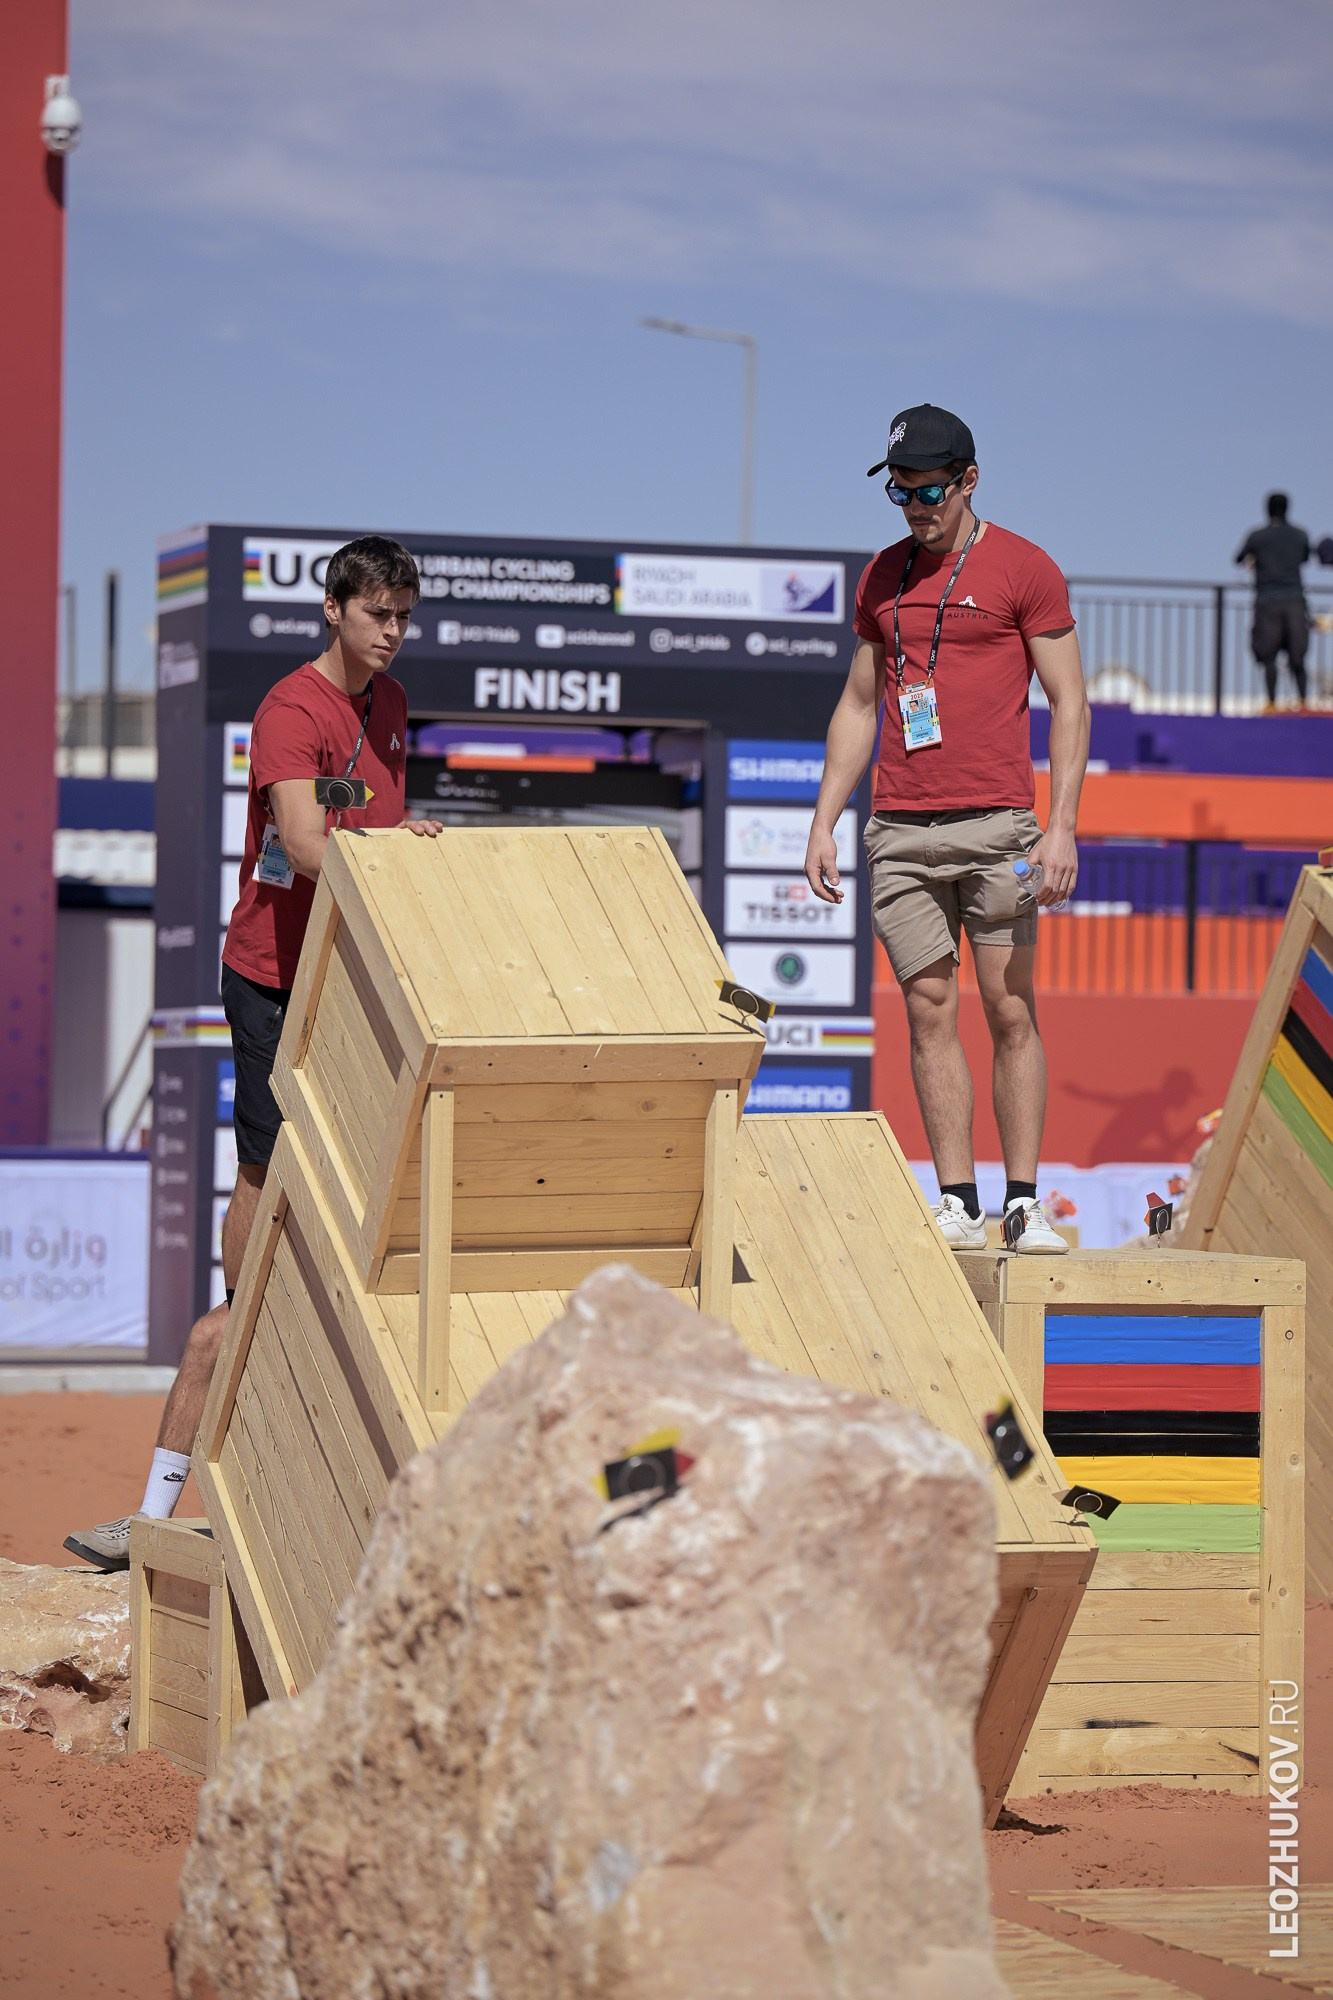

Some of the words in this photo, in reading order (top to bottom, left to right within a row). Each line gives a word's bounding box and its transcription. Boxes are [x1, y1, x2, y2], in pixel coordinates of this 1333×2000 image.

[268, 553, 331, 588] UC
[423, 555, 490, 577] URBAN
[491, 557, 575, 581] CYCLING
[450, 578, 611, 604] CHAMPIONSHIPS
[947, 612, 988, 620] AUSTRIA
[475, 667, 621, 712] FINISH
[729, 757, 825, 783] SHIMA
[745, 902, 836, 923] TISSOT
[765, 1023, 814, 1046] UCI
[744, 1084, 851, 1110] HIMANO
[31, 1271, 107, 1305] Sport
